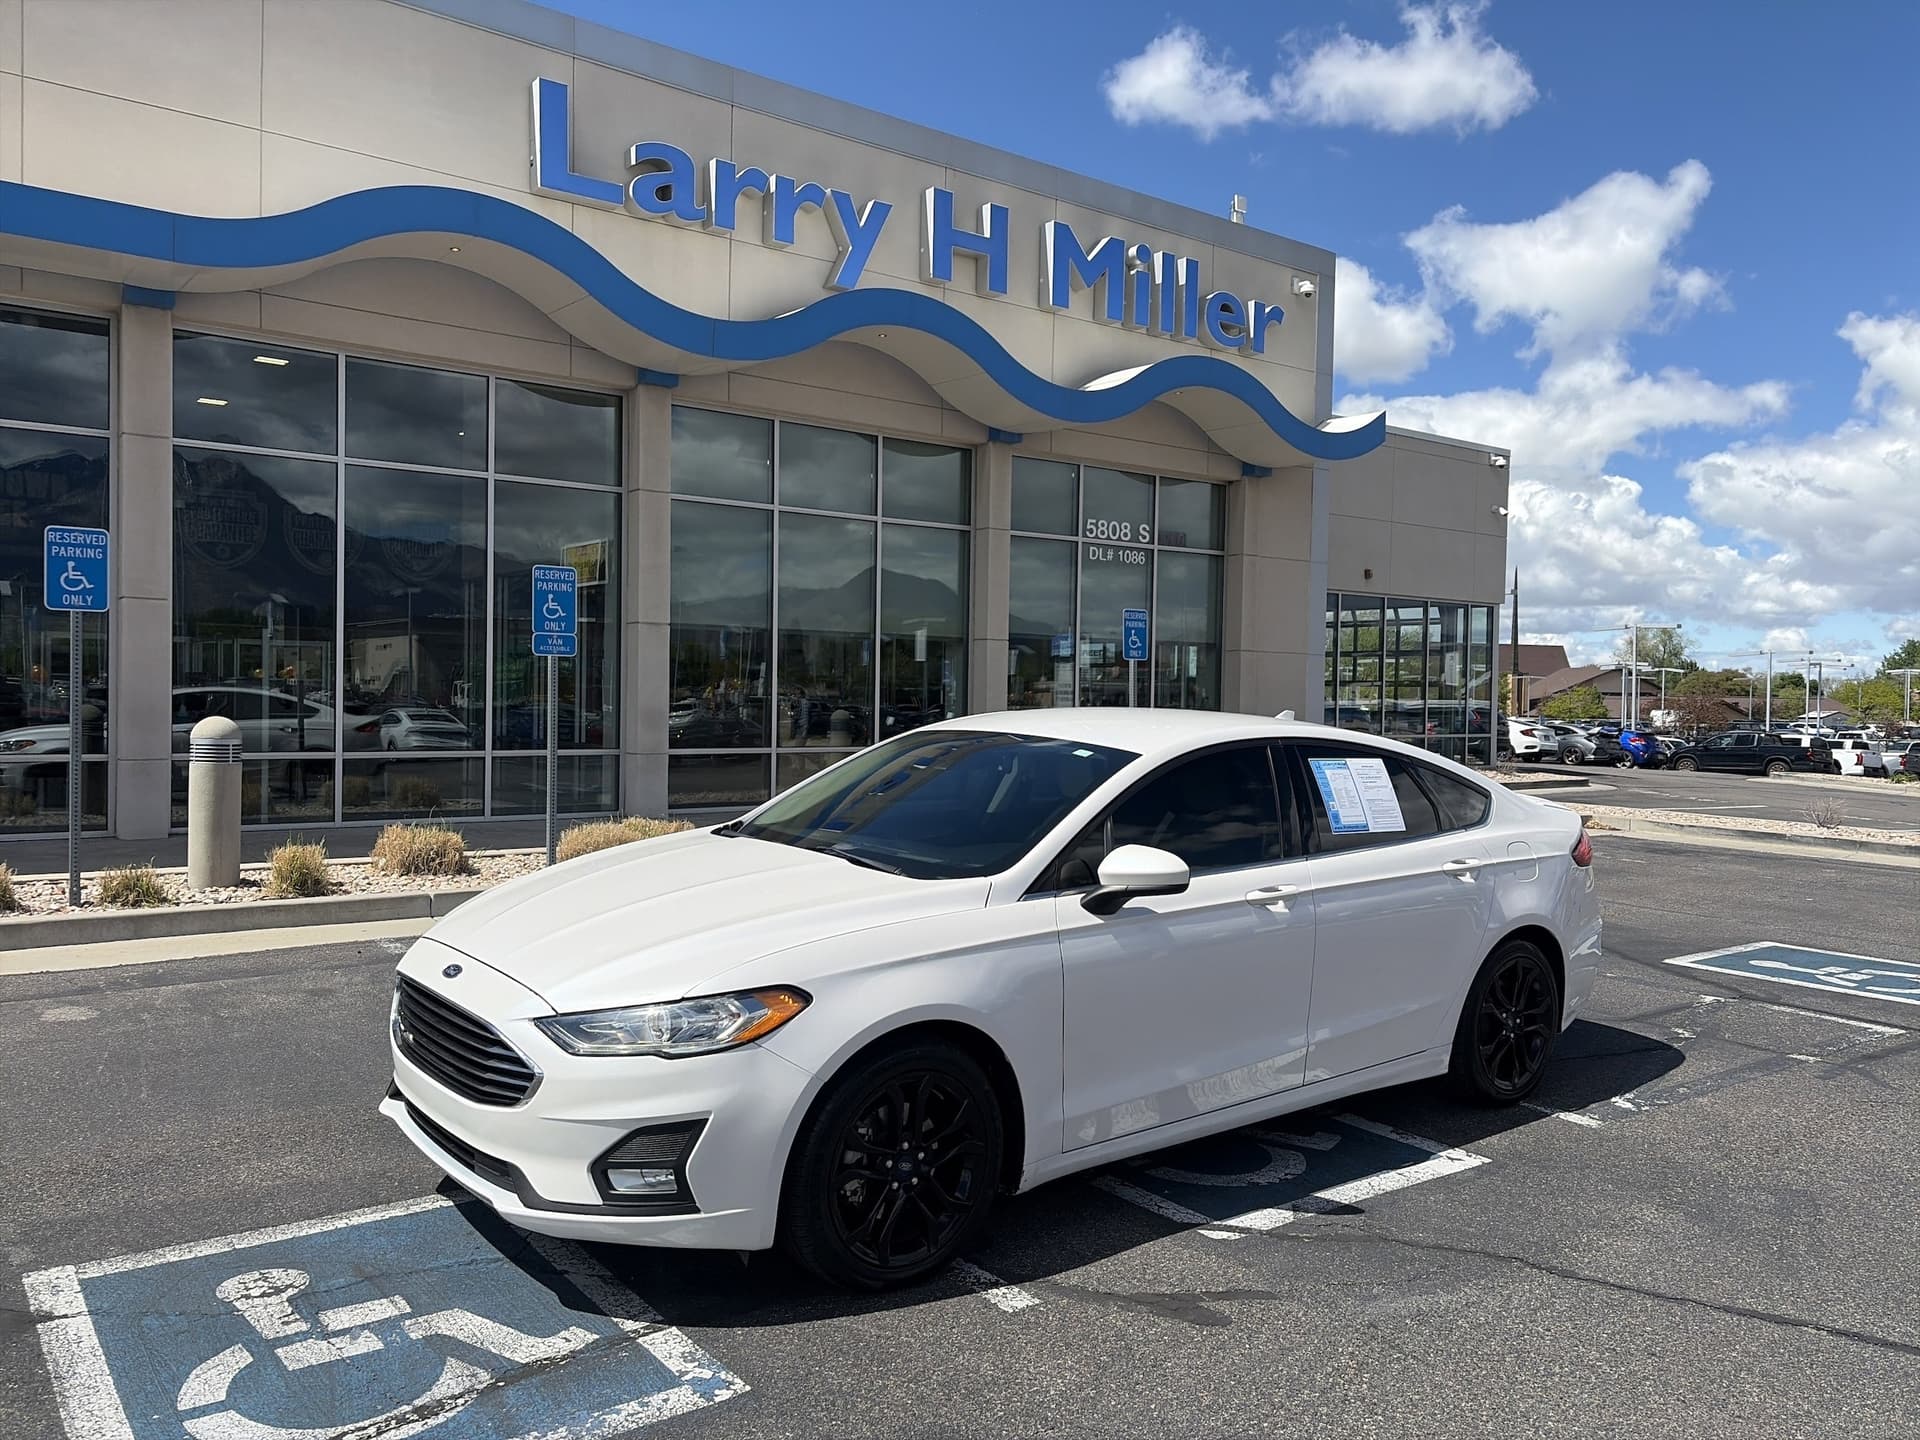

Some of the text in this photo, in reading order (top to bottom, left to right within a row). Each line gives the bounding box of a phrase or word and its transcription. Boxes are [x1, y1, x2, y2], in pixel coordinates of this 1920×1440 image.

[532, 76, 1285, 354] Larry H Miller
[1086, 518, 1131, 541] 5808
[1138, 523, 1151, 543] S
[48, 531, 106, 546] RESERVED
[51, 546, 103, 559] PARKING
[1089, 546, 1146, 565] DL# 1086
[534, 569, 575, 581] RESERVED
[537, 581, 573, 593] PARKING
[62, 594, 93, 606] ONLY
[544, 621, 567, 631] ONLY
[548, 638, 563, 646] VAN
[1129, 649, 1142, 657] ONLY
